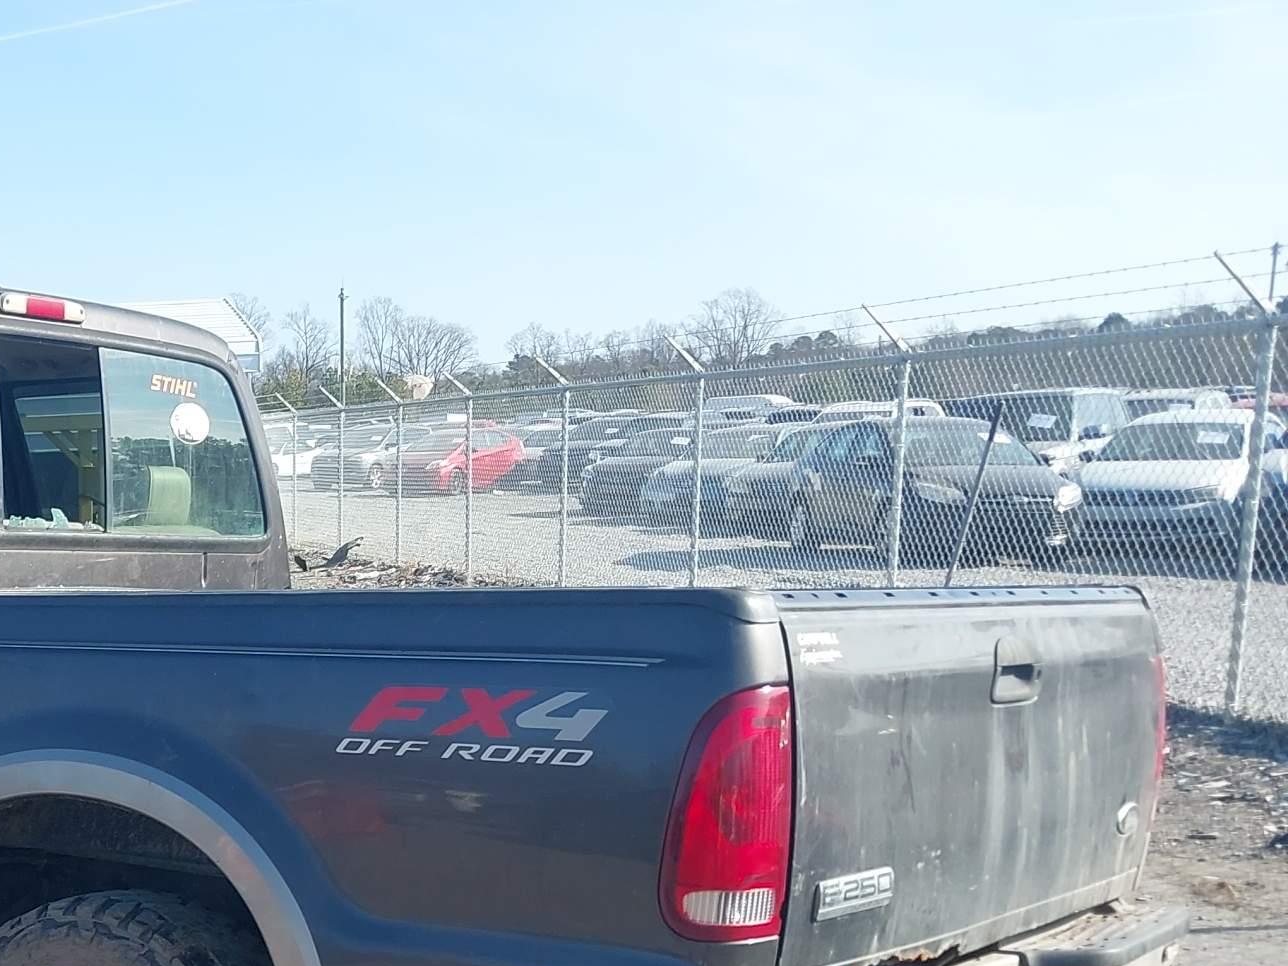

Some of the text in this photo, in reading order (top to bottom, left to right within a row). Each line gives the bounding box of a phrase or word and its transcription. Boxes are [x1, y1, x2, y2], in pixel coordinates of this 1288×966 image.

[150, 374, 196, 398] STIHL
[349, 686, 608, 741] FX4
[335, 737, 594, 766] OFF ROAD
